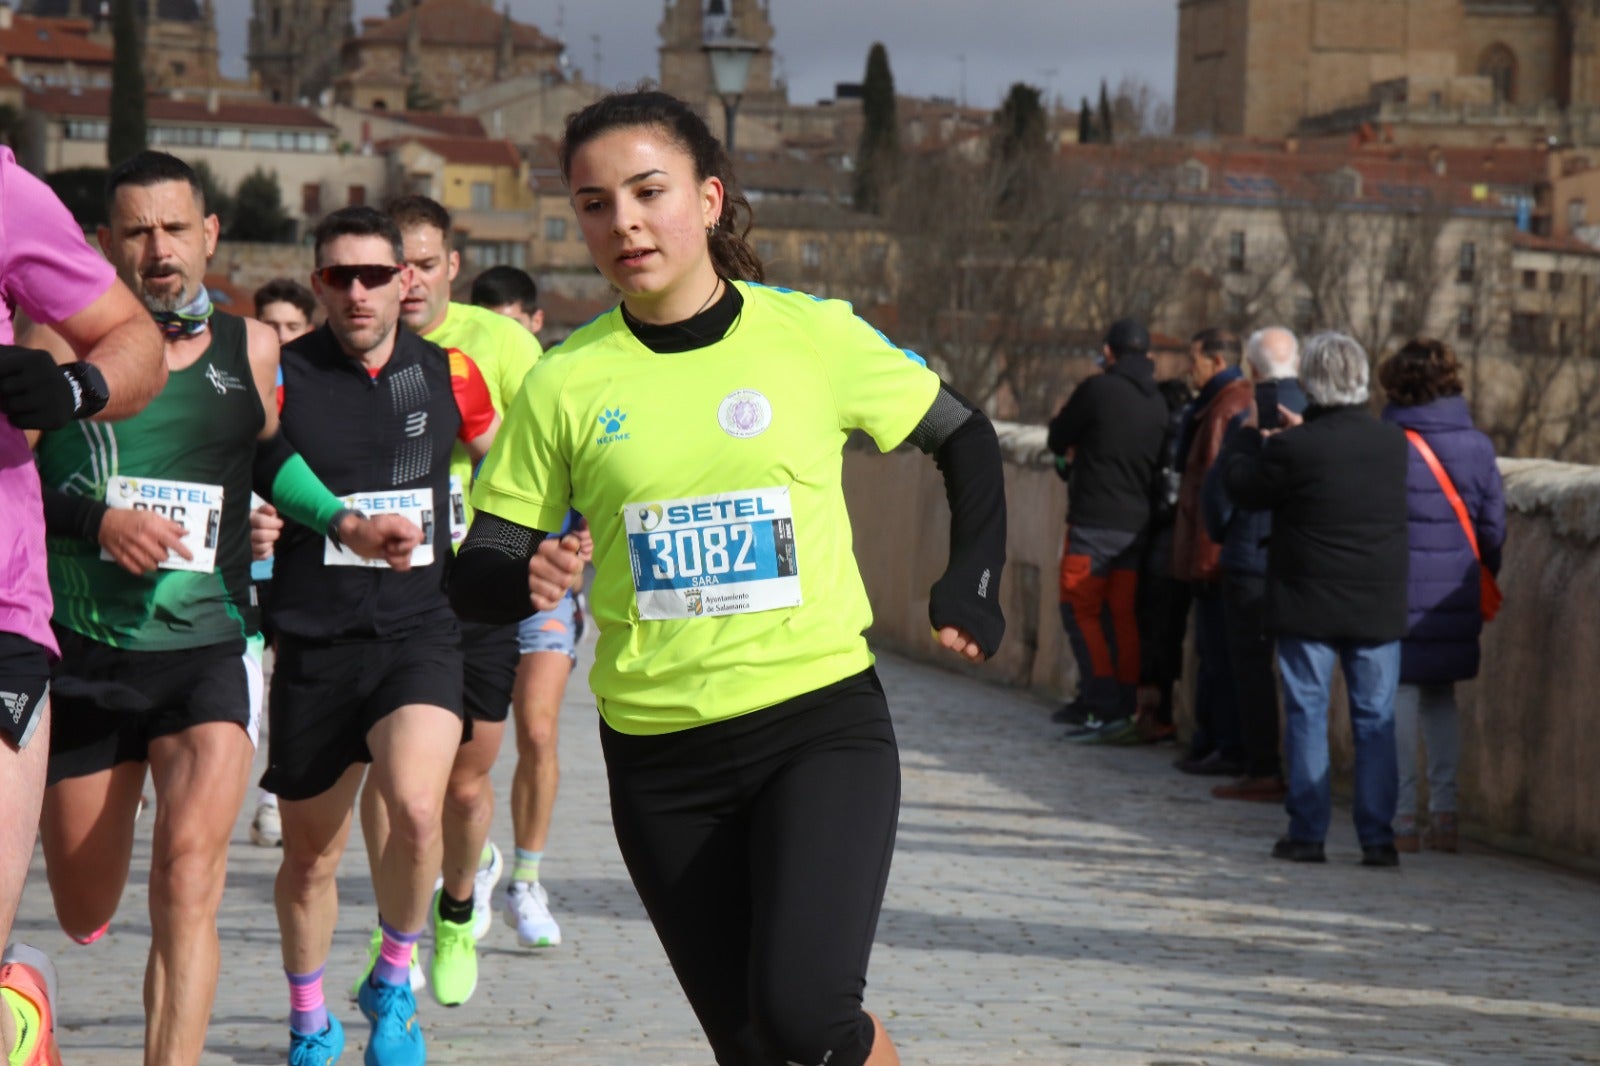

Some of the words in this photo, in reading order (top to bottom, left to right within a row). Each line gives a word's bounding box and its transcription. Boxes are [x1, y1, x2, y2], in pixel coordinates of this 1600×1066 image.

[596, 433, 630, 444] KELME
[140, 485, 212, 504] SETEL
[358, 493, 422, 510] SETEL
[667, 496, 775, 525] SETEL
[648, 524, 757, 580] 3082
[691, 575, 720, 587] SARA
[705, 592, 750, 603] Ayuntamiento
[715, 602, 750, 612] Salamanca
[13, 692, 29, 724] adidas
